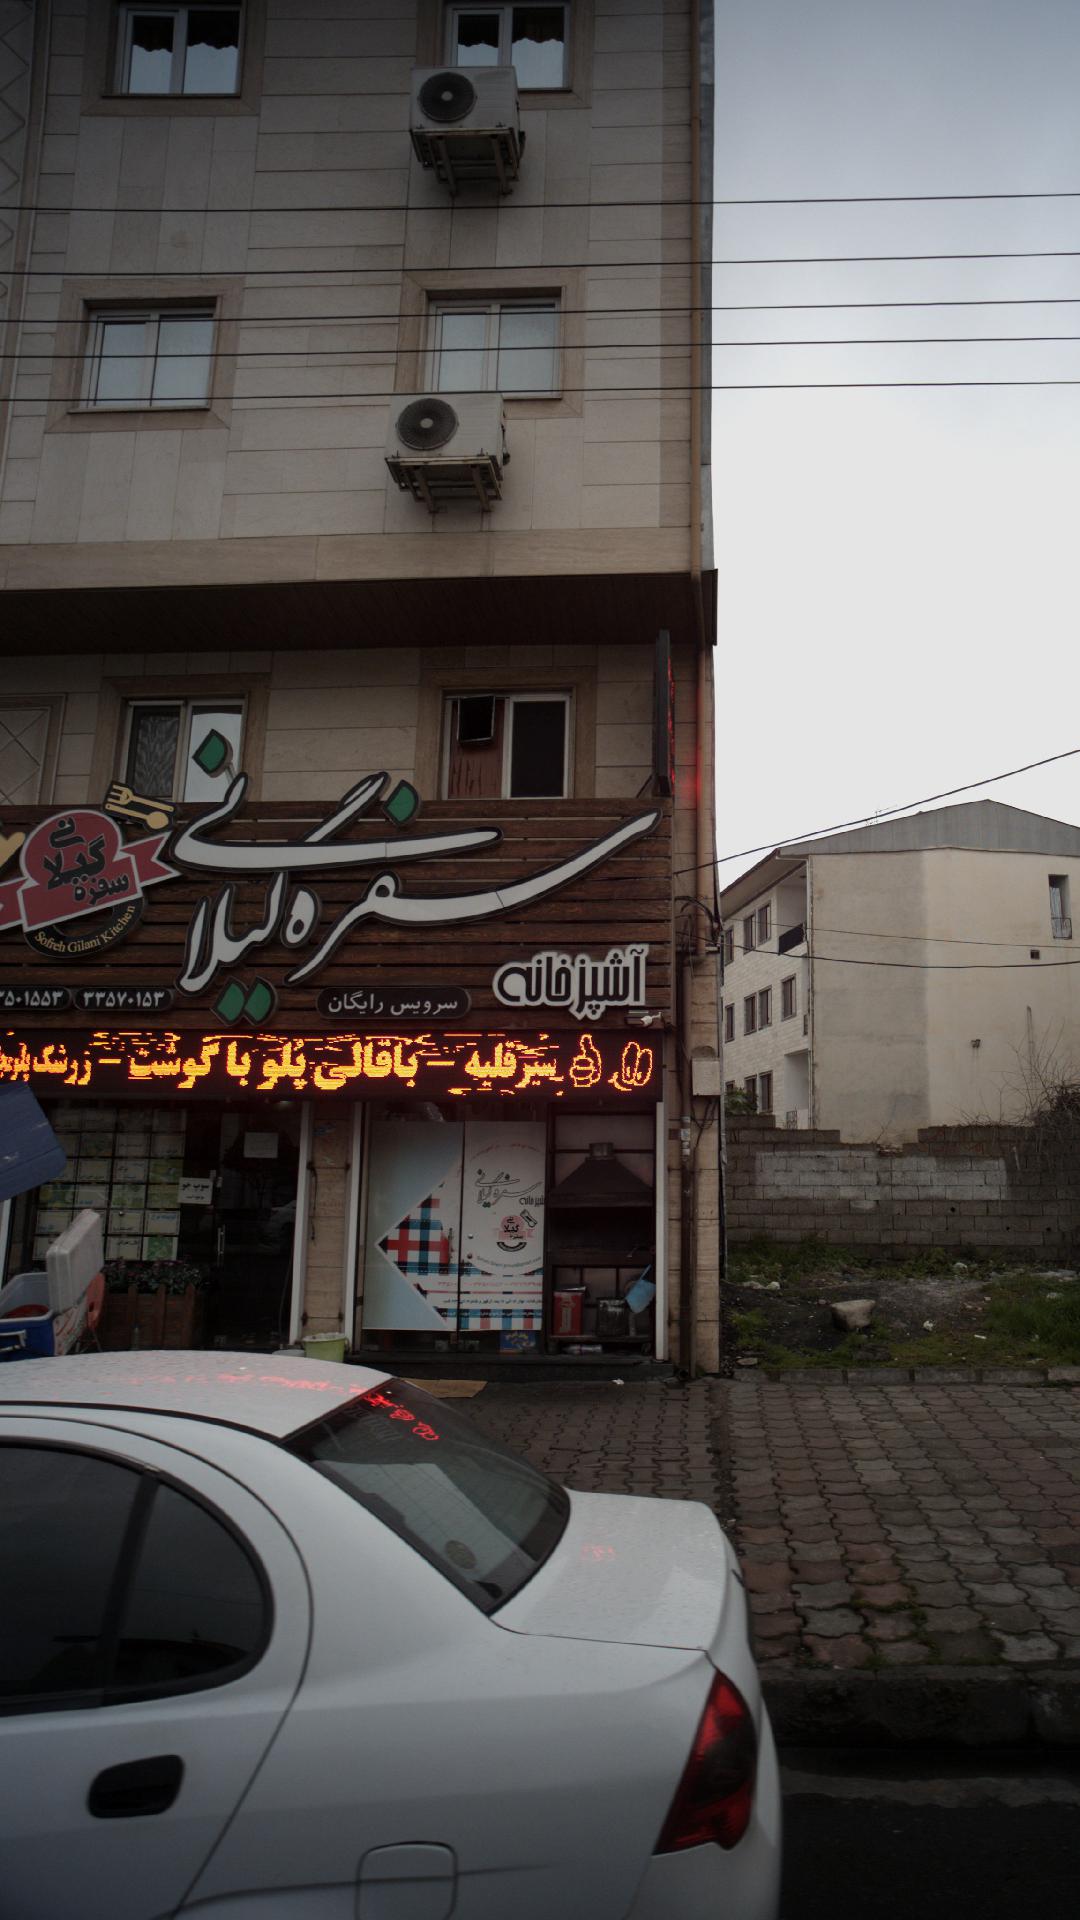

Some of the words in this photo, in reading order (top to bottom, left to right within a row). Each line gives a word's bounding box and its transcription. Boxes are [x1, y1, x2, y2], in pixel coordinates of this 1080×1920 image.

[73, 873, 129, 906] سفره
[172, 731, 506, 1028] گیلانی
[282, 780, 663, 986] سفره
[34, 929, 66, 954] Sofreh
[67, 938, 101, 953] Gilani
[101, 904, 136, 944] Kitchen
[83, 990, 165, 1009] ۳۳۵۷۰۱۵۳
[327, 991, 385, 1012] رایگان
[496, 946, 646, 1017] آشپزخانه
[390, 997, 458, 1014] سرویس
[227, 1041, 251, 1087] با
